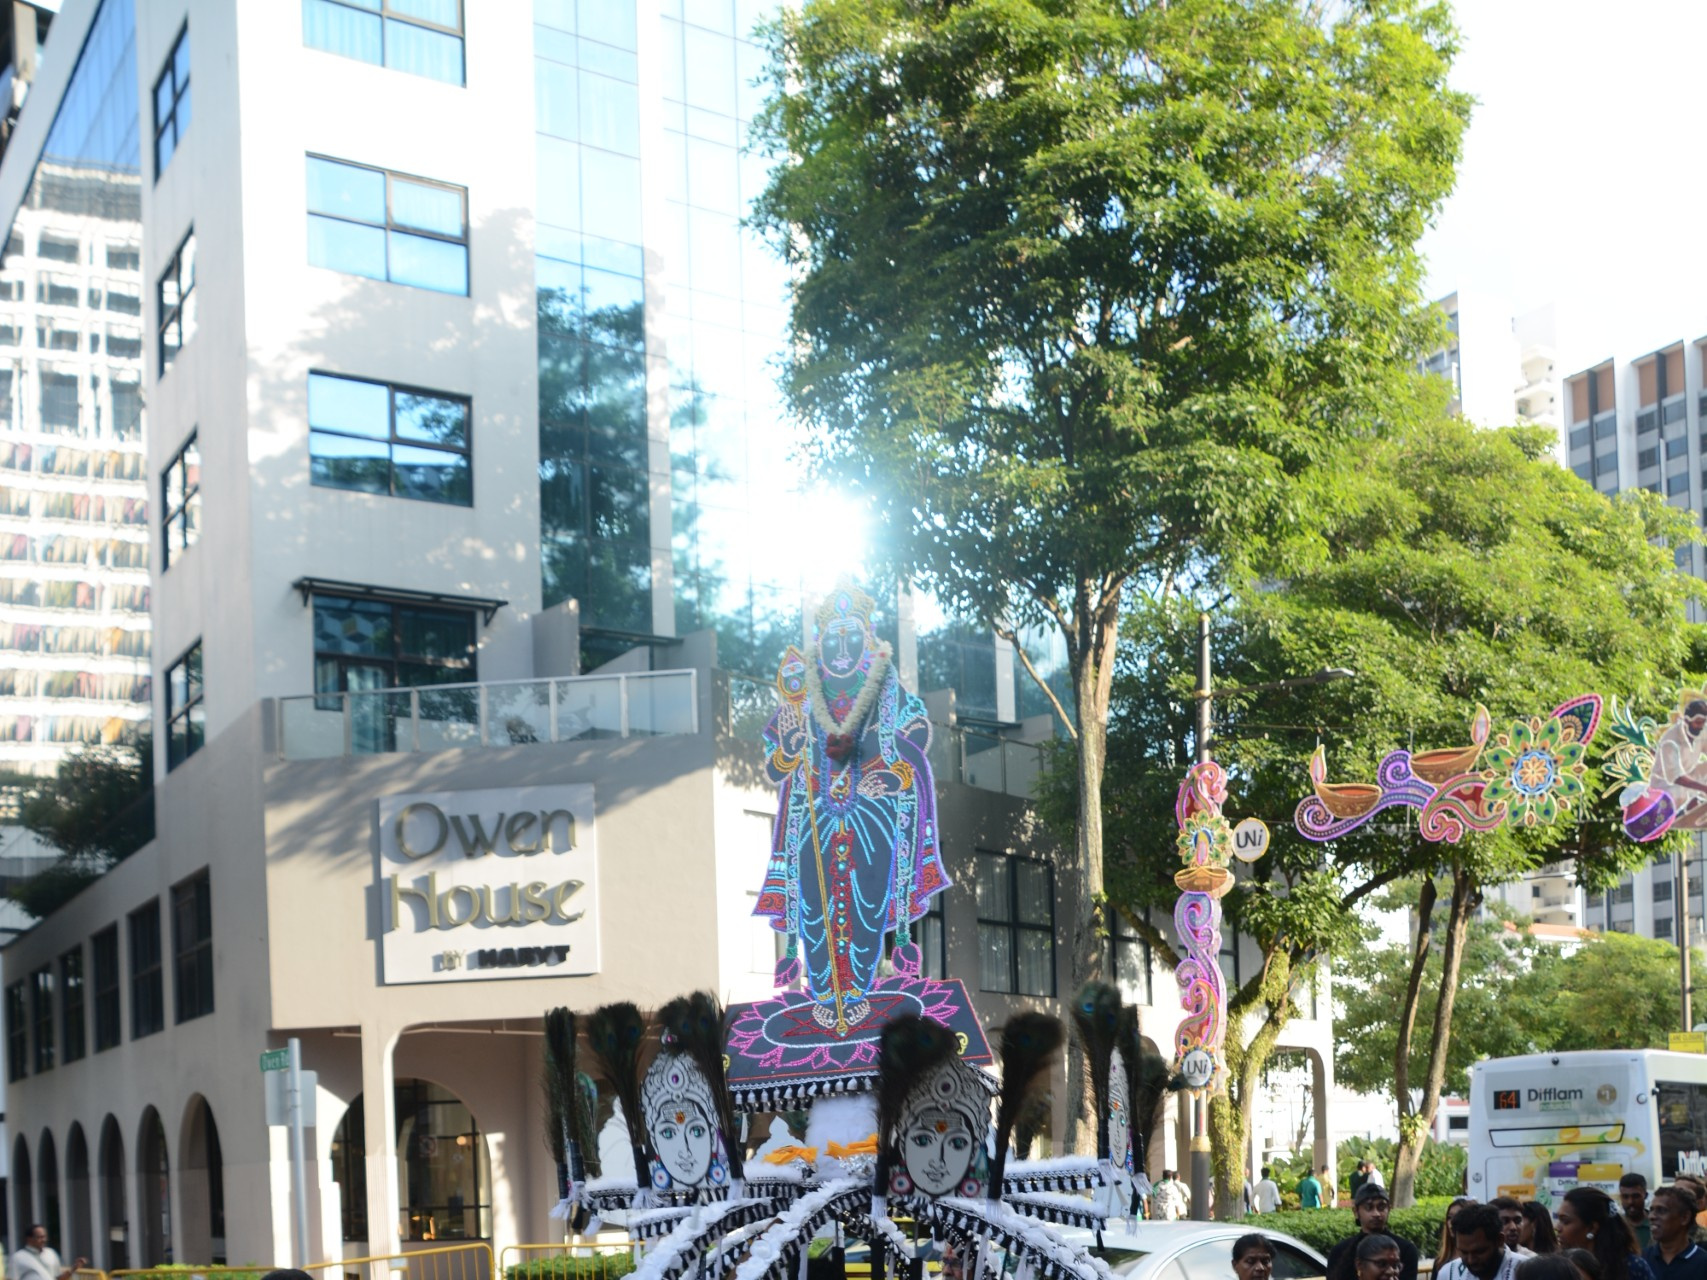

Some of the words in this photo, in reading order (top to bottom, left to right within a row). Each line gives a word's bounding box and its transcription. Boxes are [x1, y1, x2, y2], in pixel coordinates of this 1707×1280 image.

[394, 801, 578, 860] Owen
[390, 870, 586, 931] House
[1499, 1090, 1516, 1110] 64
[1527, 1087, 1583, 1102] Difflam
